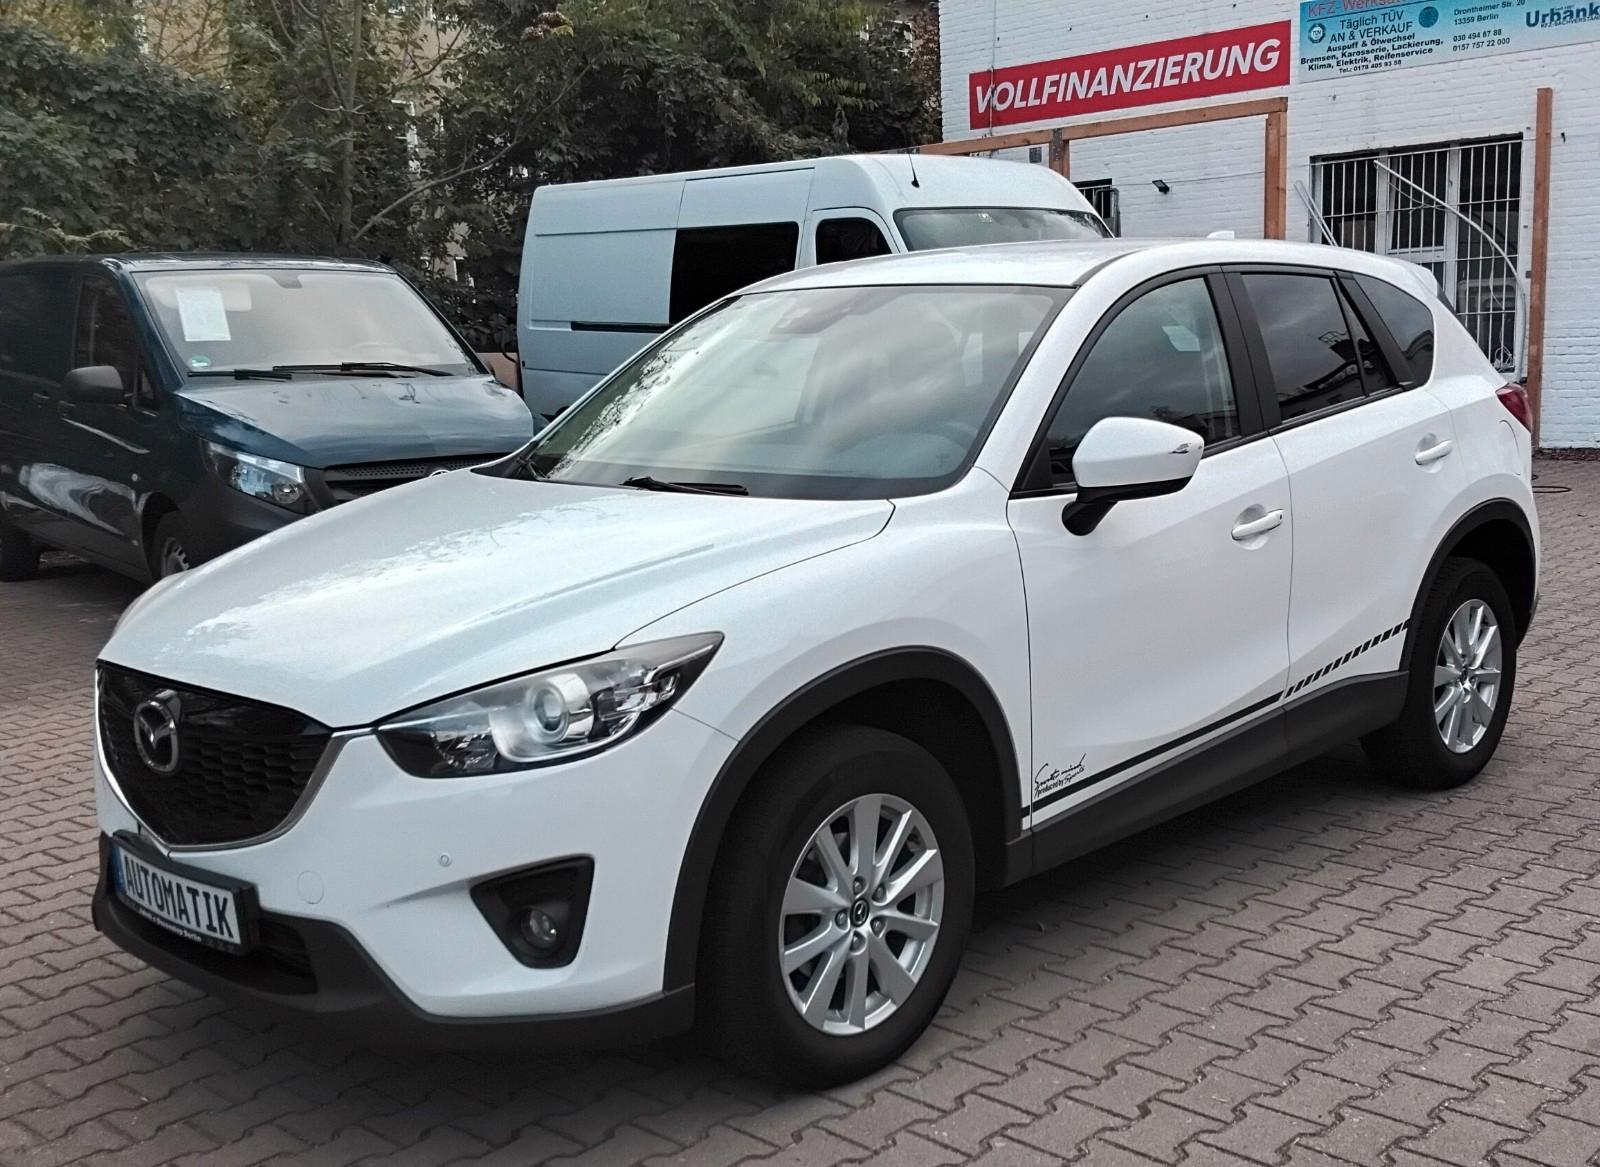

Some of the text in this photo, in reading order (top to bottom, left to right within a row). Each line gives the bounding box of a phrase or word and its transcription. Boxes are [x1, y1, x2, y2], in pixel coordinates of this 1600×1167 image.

[1340, 9, 1405, 30] Täglich TÜV
[1454, 3, 1500, 15] Drontheimer
[1454, 13, 1500, 25] 13359 Berlin
[1326, 33, 1415, 53] Auspuff & Ölwechsel
[1330, 21, 1413, 44] AN & VERKAUF
[1453, 34, 1466, 42] 030
[1300, 38, 1444, 65] Bremsen, Karosserie, Lackierung,
[1453, 37, 1511, 52] 0157 757 22 000
[1308, 48, 1433, 71] Klima, Elektrik, Reifenservice
[975, 38, 1281, 114] VOLLFINANZIERUNG
[124, 855, 234, 939] AUTOMATIK
